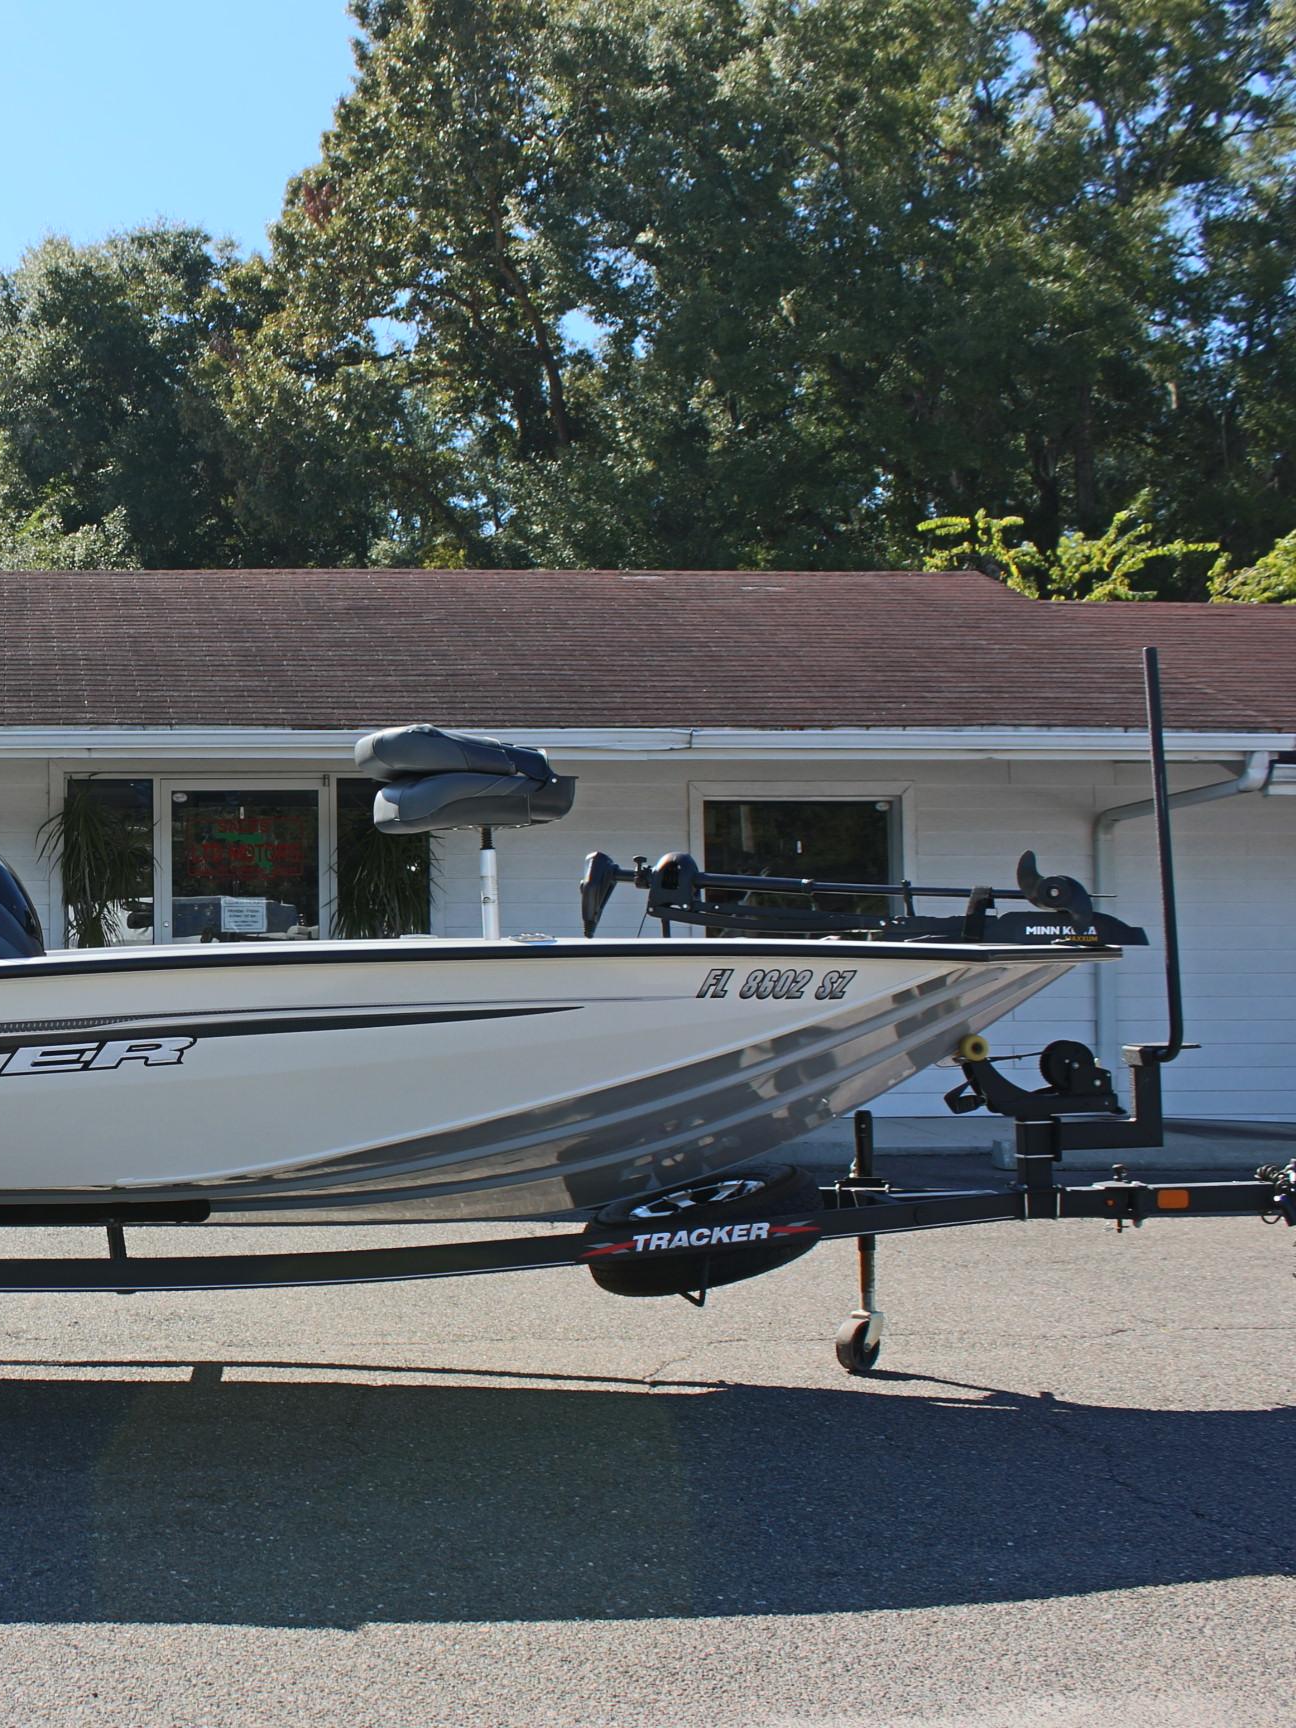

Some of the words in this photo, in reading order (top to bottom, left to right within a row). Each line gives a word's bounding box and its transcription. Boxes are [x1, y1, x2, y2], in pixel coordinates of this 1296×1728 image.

[1025, 926, 1060, 935] MINN
[1062, 926, 1097, 935] KA
[696, 969, 735, 999] FL
[739, 969, 813, 1000] 8602
[815, 970, 858, 1000] SZ
[632, 1222, 771, 1252] TRACKER
